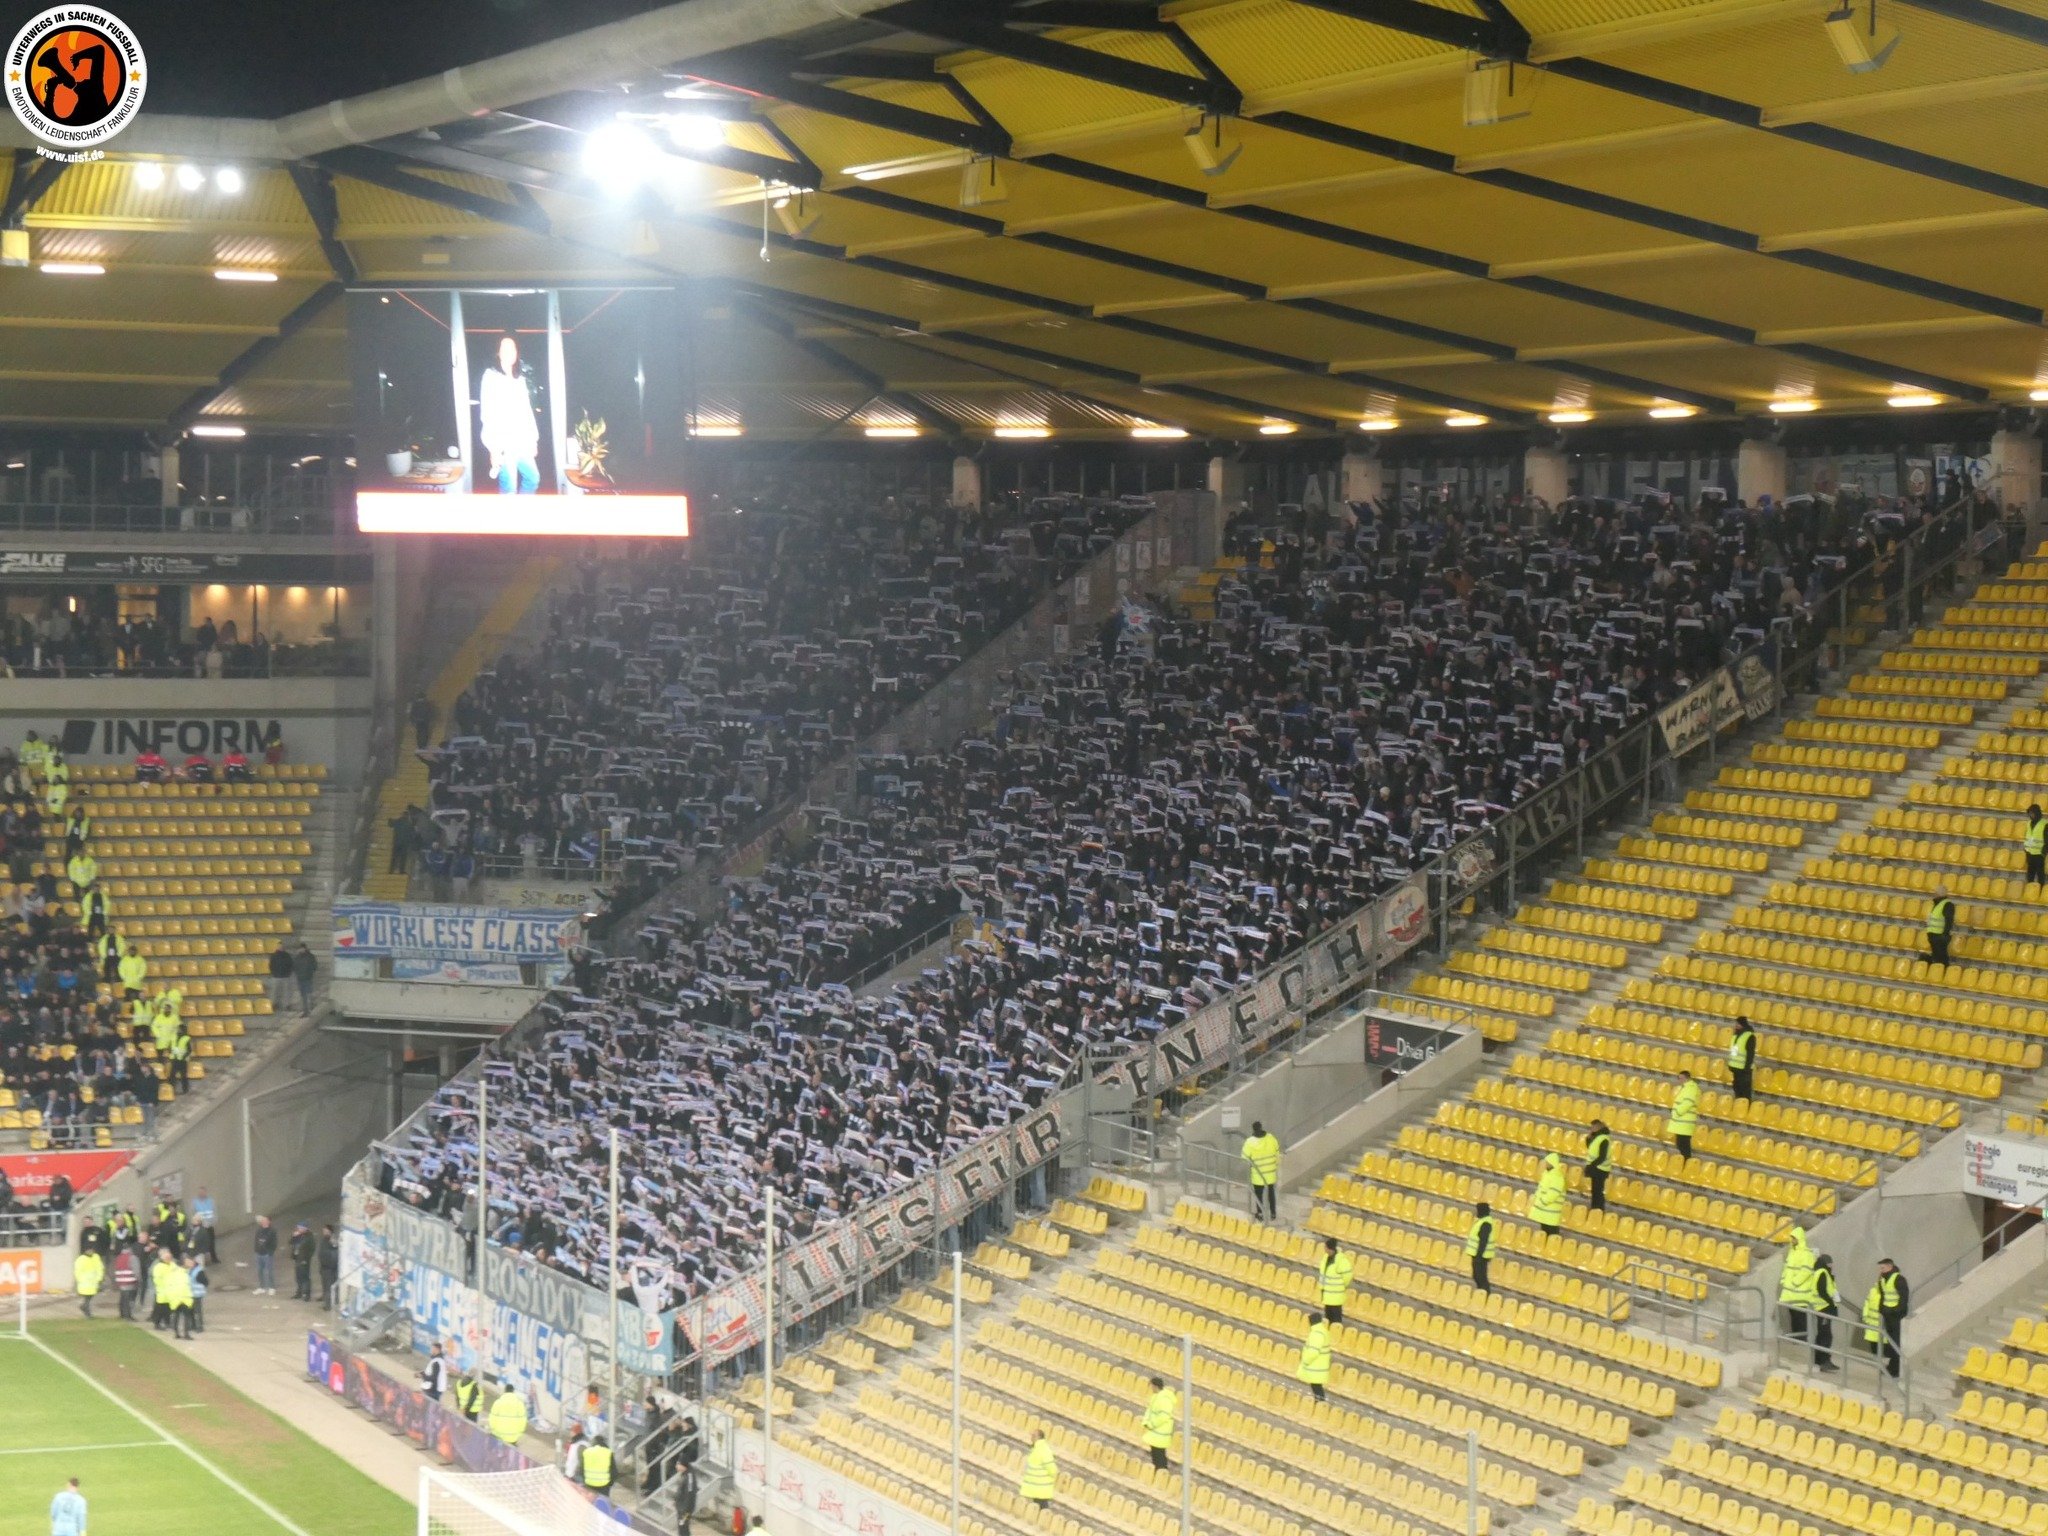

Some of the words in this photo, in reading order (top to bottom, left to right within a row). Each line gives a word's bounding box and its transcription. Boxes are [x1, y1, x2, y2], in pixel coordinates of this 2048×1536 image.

[103, 719, 282, 754] INFORM
[351, 915, 474, 950] WORKLESS
[482, 919, 560, 952] CLASS
